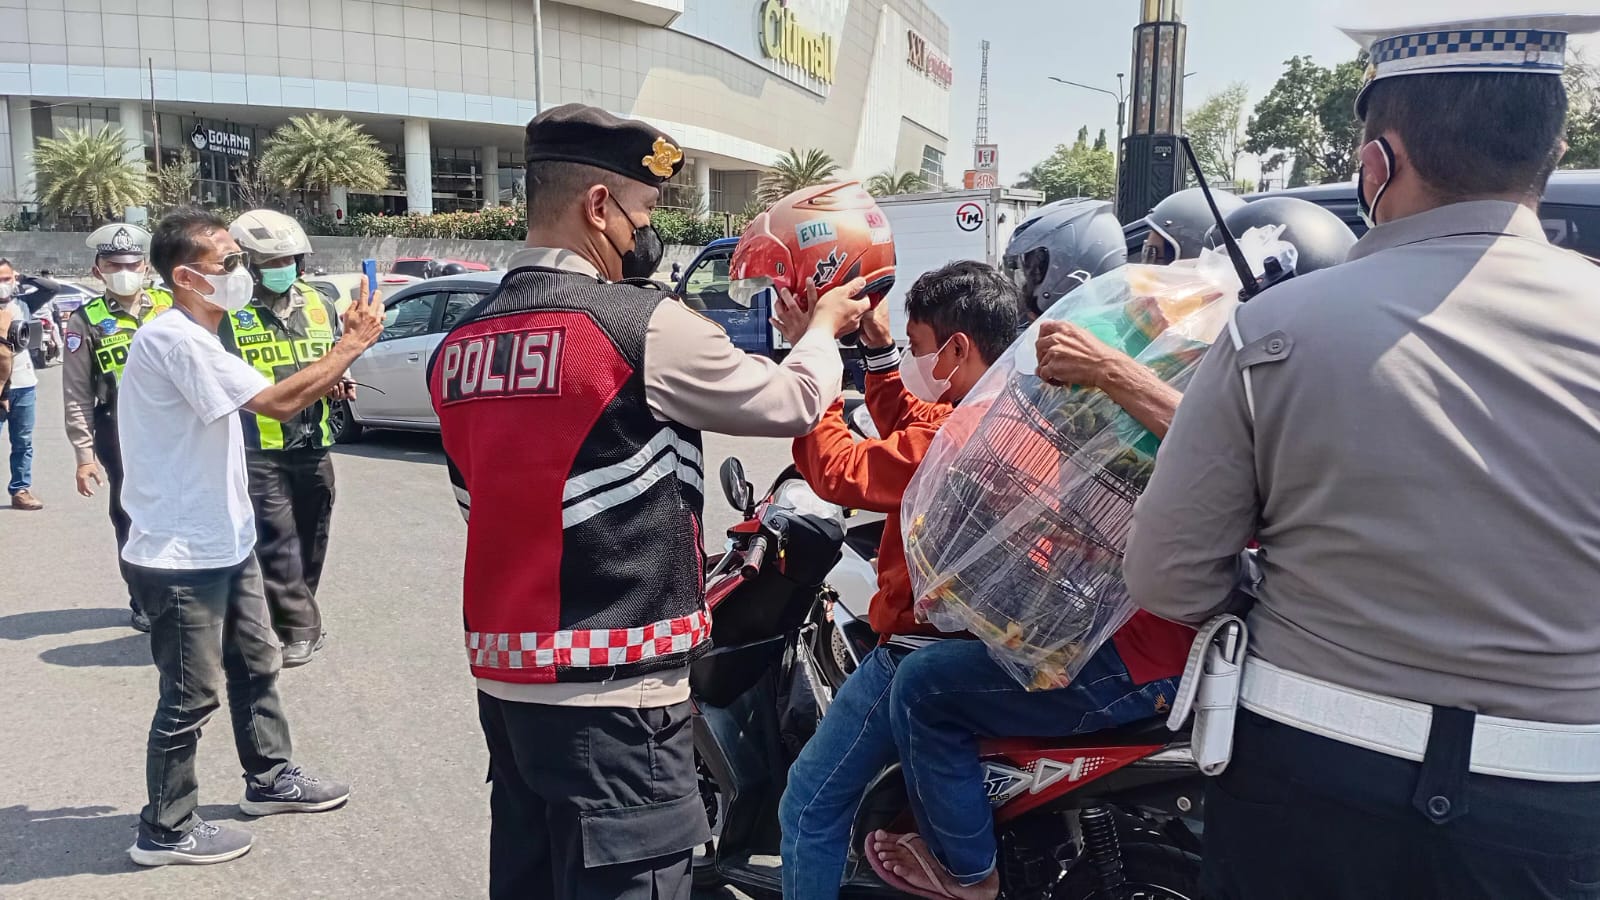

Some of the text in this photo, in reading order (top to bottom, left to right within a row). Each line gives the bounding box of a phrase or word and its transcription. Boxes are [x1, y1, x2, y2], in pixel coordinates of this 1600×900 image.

[208, 130, 250, 150] GOKANA
[800, 223, 833, 243] EVIL
[442, 331, 561, 400] POLISI
